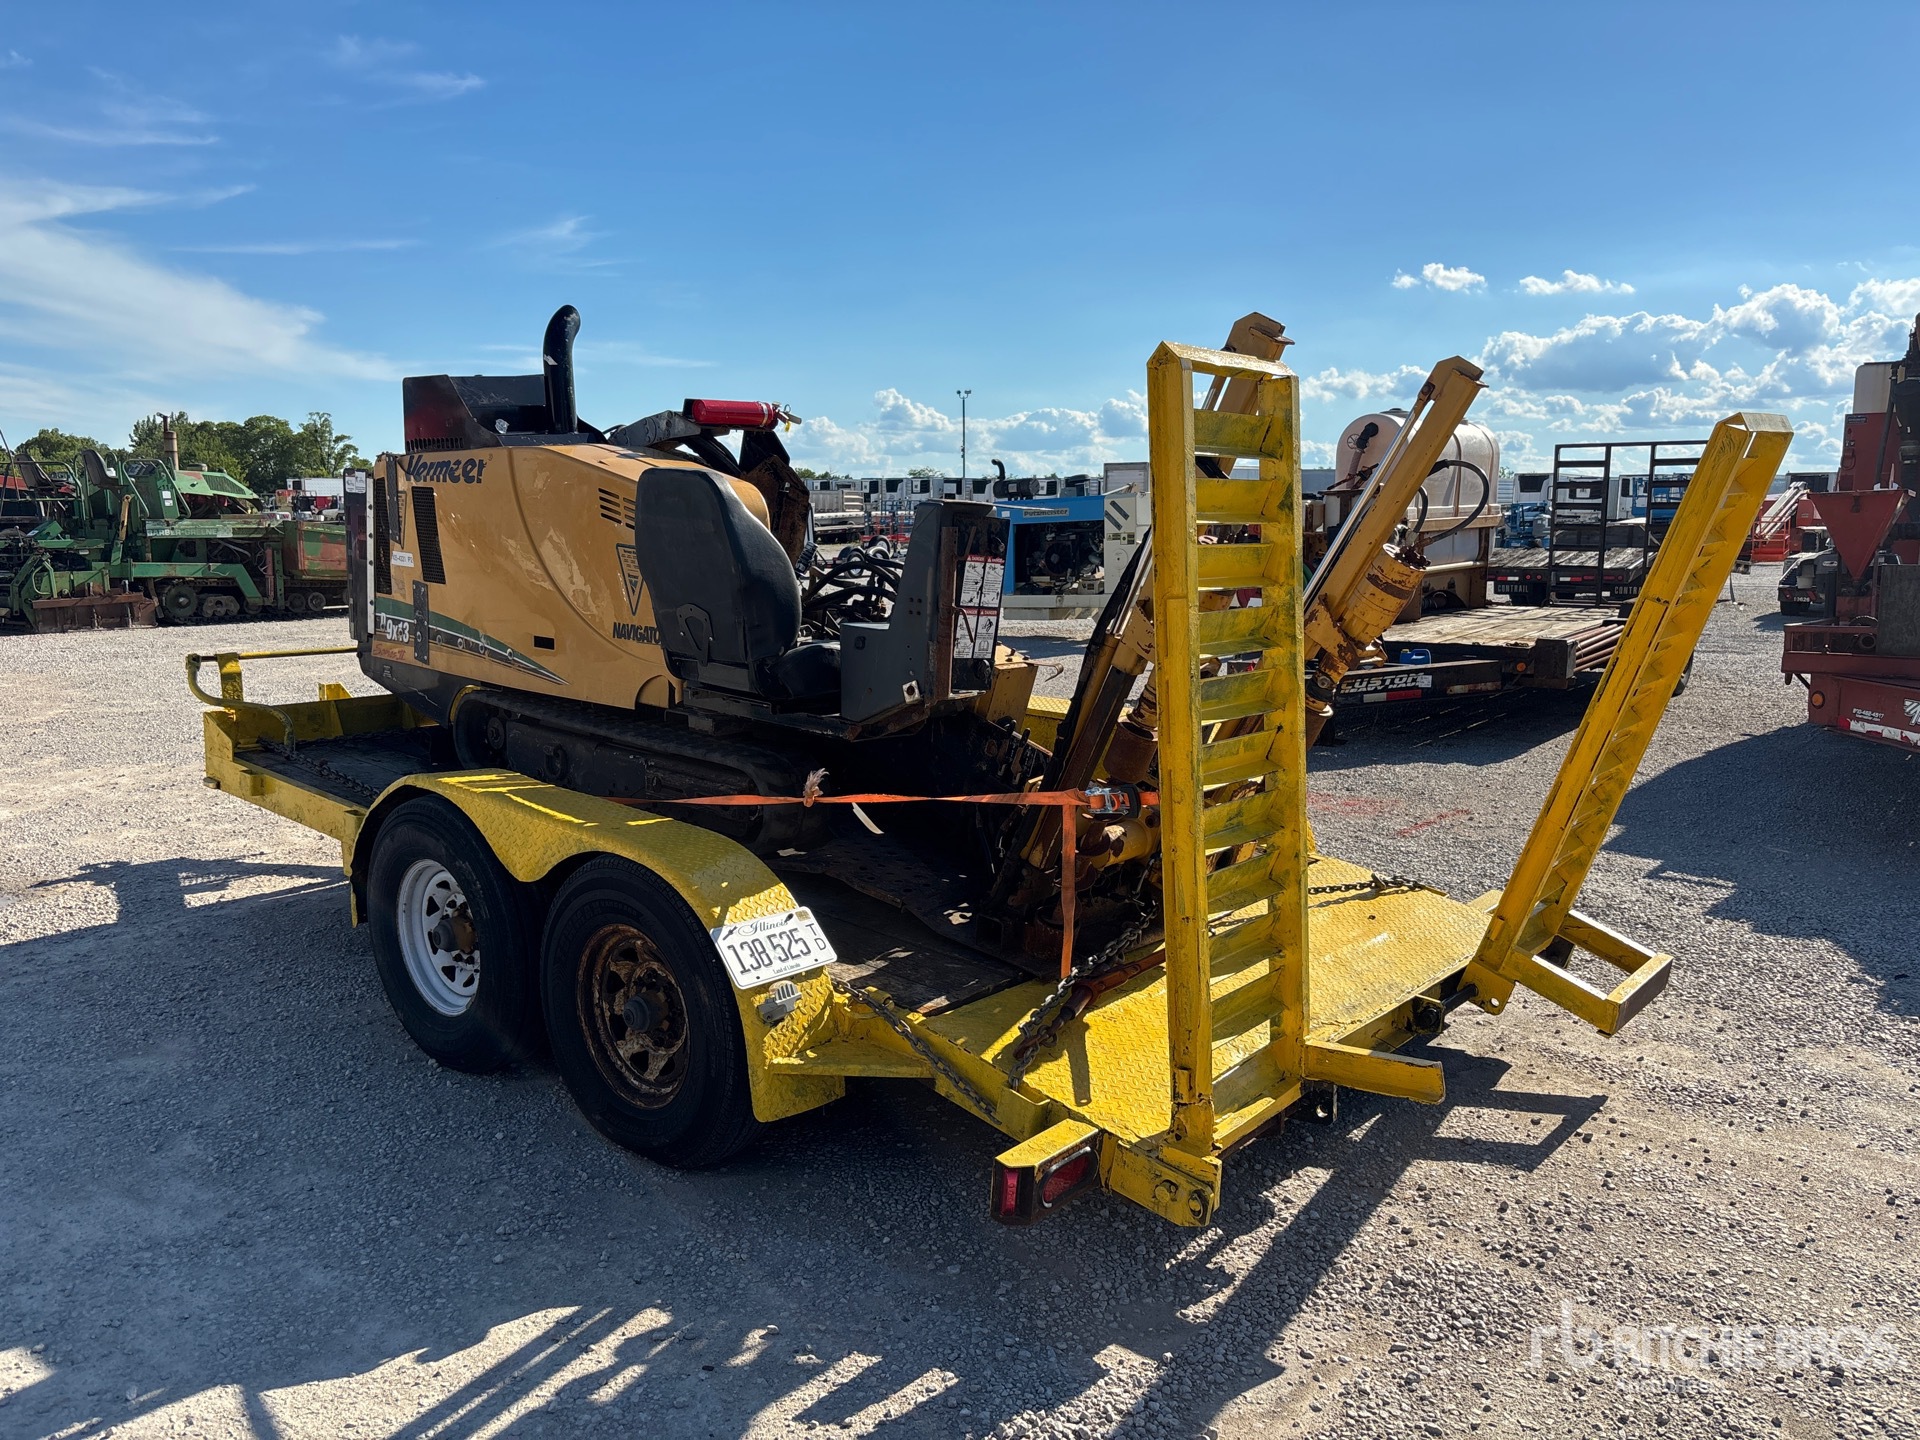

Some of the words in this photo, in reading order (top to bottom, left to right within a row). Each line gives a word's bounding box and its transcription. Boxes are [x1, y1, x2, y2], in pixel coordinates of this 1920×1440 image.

[405, 454, 488, 484] Vermeer
[1497, 584, 1529, 593] CONTRAIL
[1614, 586, 1642, 595] CONTR
[612, 621, 662, 645] NAVIGATO
[738, 920, 789, 937] Illinois
[727, 938, 774, 975] 138
[766, 927, 812, 963] 525
